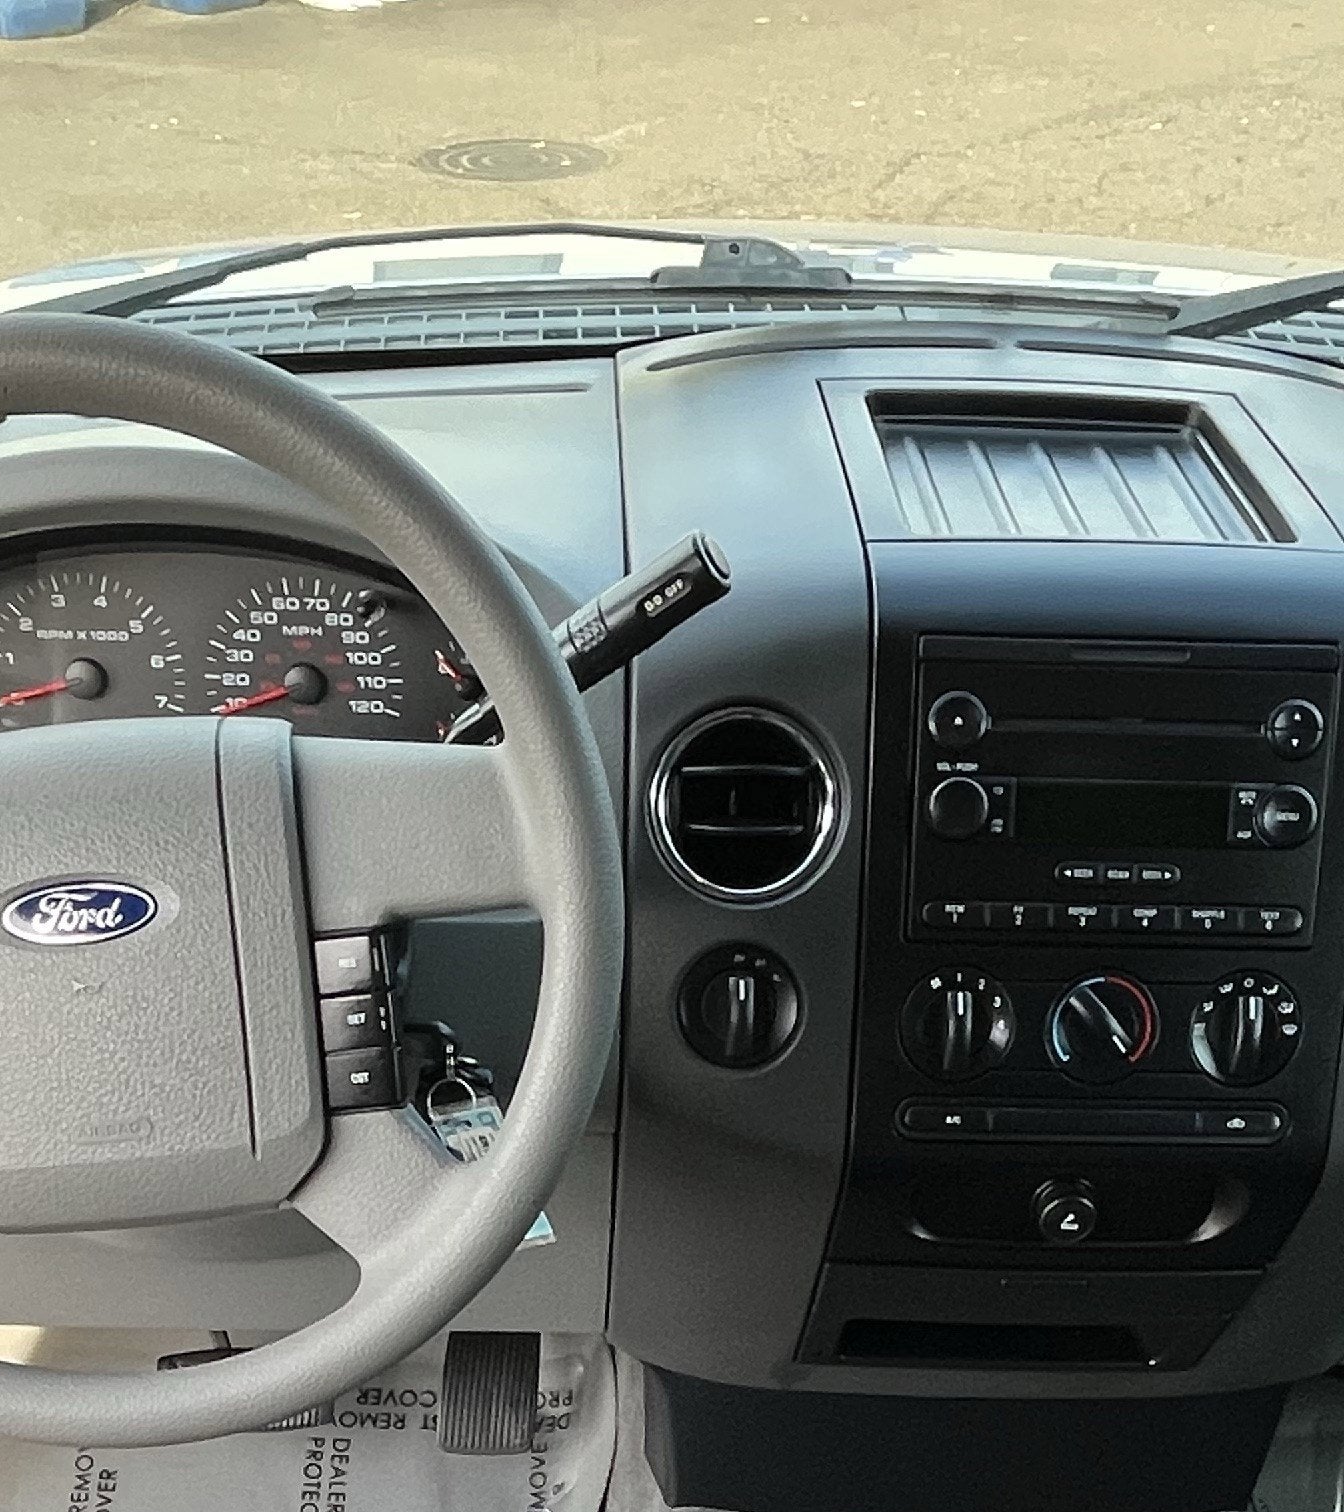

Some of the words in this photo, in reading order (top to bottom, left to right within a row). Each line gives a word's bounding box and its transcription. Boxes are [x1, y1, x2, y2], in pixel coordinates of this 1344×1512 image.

[93, 596, 108, 609] 4
[272, 597, 300, 610] 60
[303, 598, 330, 611] 70
[19, 617, 34, 631] 2
[325, 613, 354, 626] 80
[129, 620, 144, 635] 5
[282, 625, 323, 638] MPH
[90, 630, 130, 642] 1000
[232, 629, 261, 642] 40
[341, 631, 370, 644] 90
[225, 649, 254, 663] 30
[345, 652, 383, 665] 100
[222, 672, 251, 686] 20
[356, 676, 387, 689] 110
[154, 694, 169, 709] 7
[348, 701, 385, 714] 120
[30, 891, 125, 935] Ford
[356, 1387, 438, 1408] COVER
